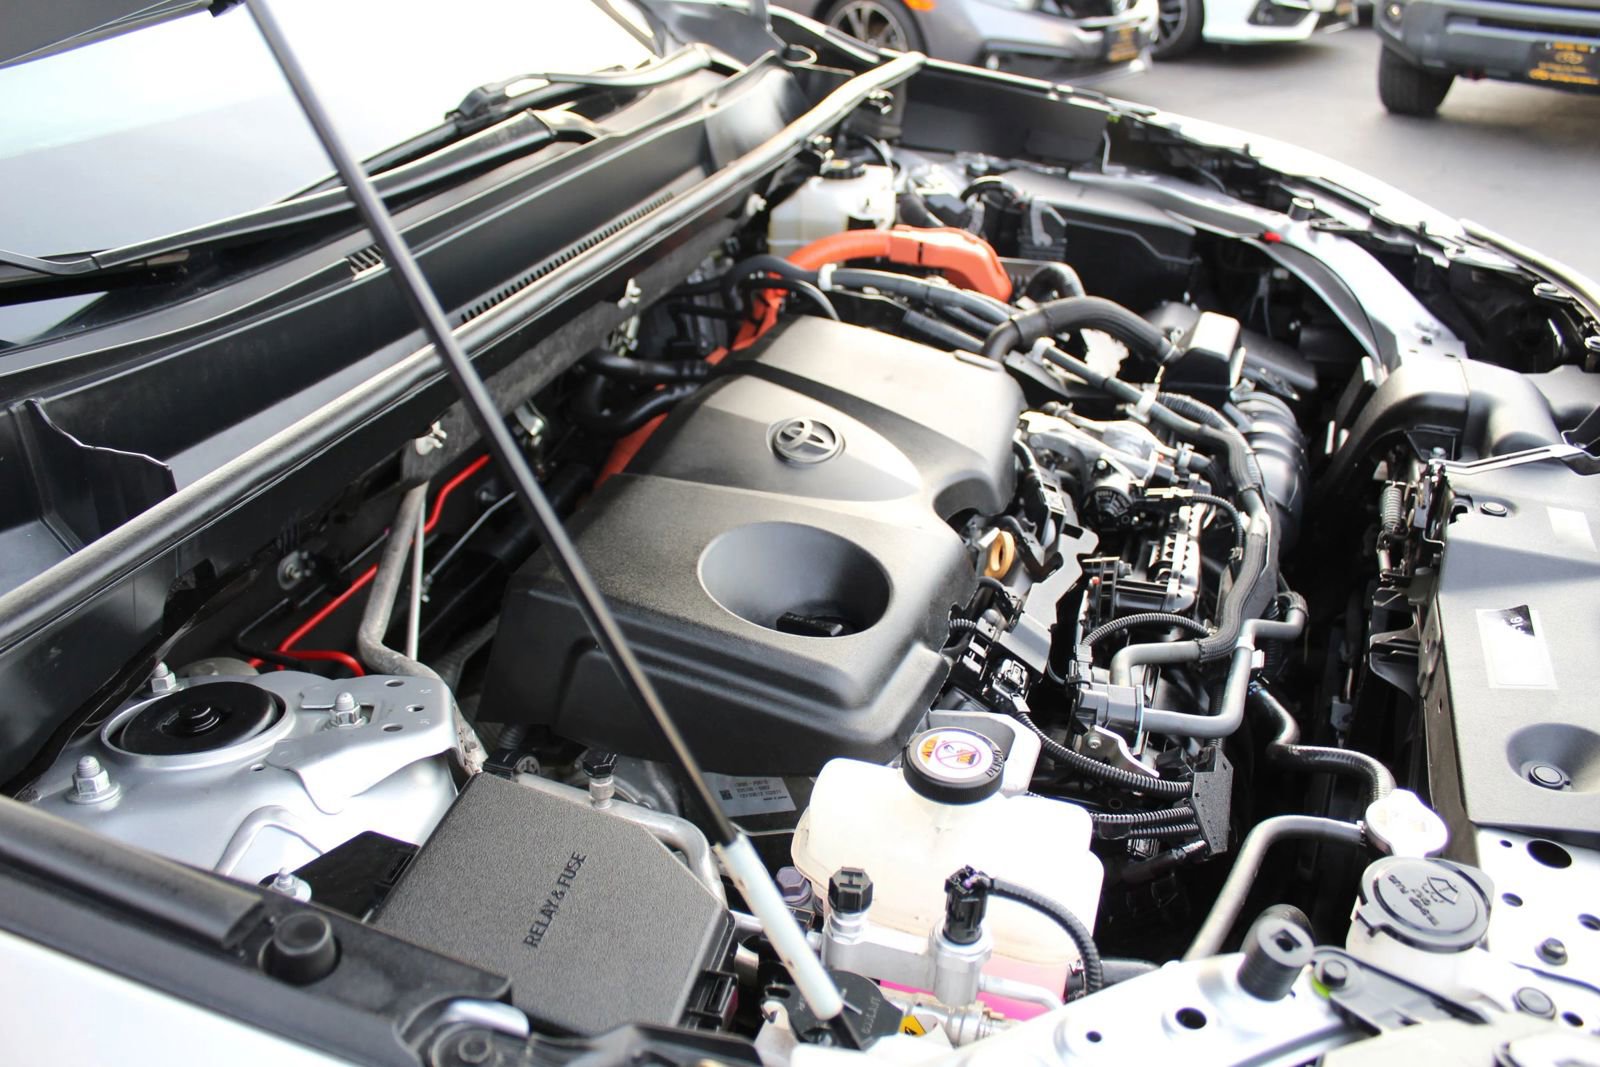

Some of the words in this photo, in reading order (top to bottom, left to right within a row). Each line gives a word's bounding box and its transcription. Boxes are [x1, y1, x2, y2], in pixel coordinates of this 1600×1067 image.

[557, 851, 587, 889] FUSE
[551, 889, 565, 901] &
[523, 899, 559, 948] RELAY
